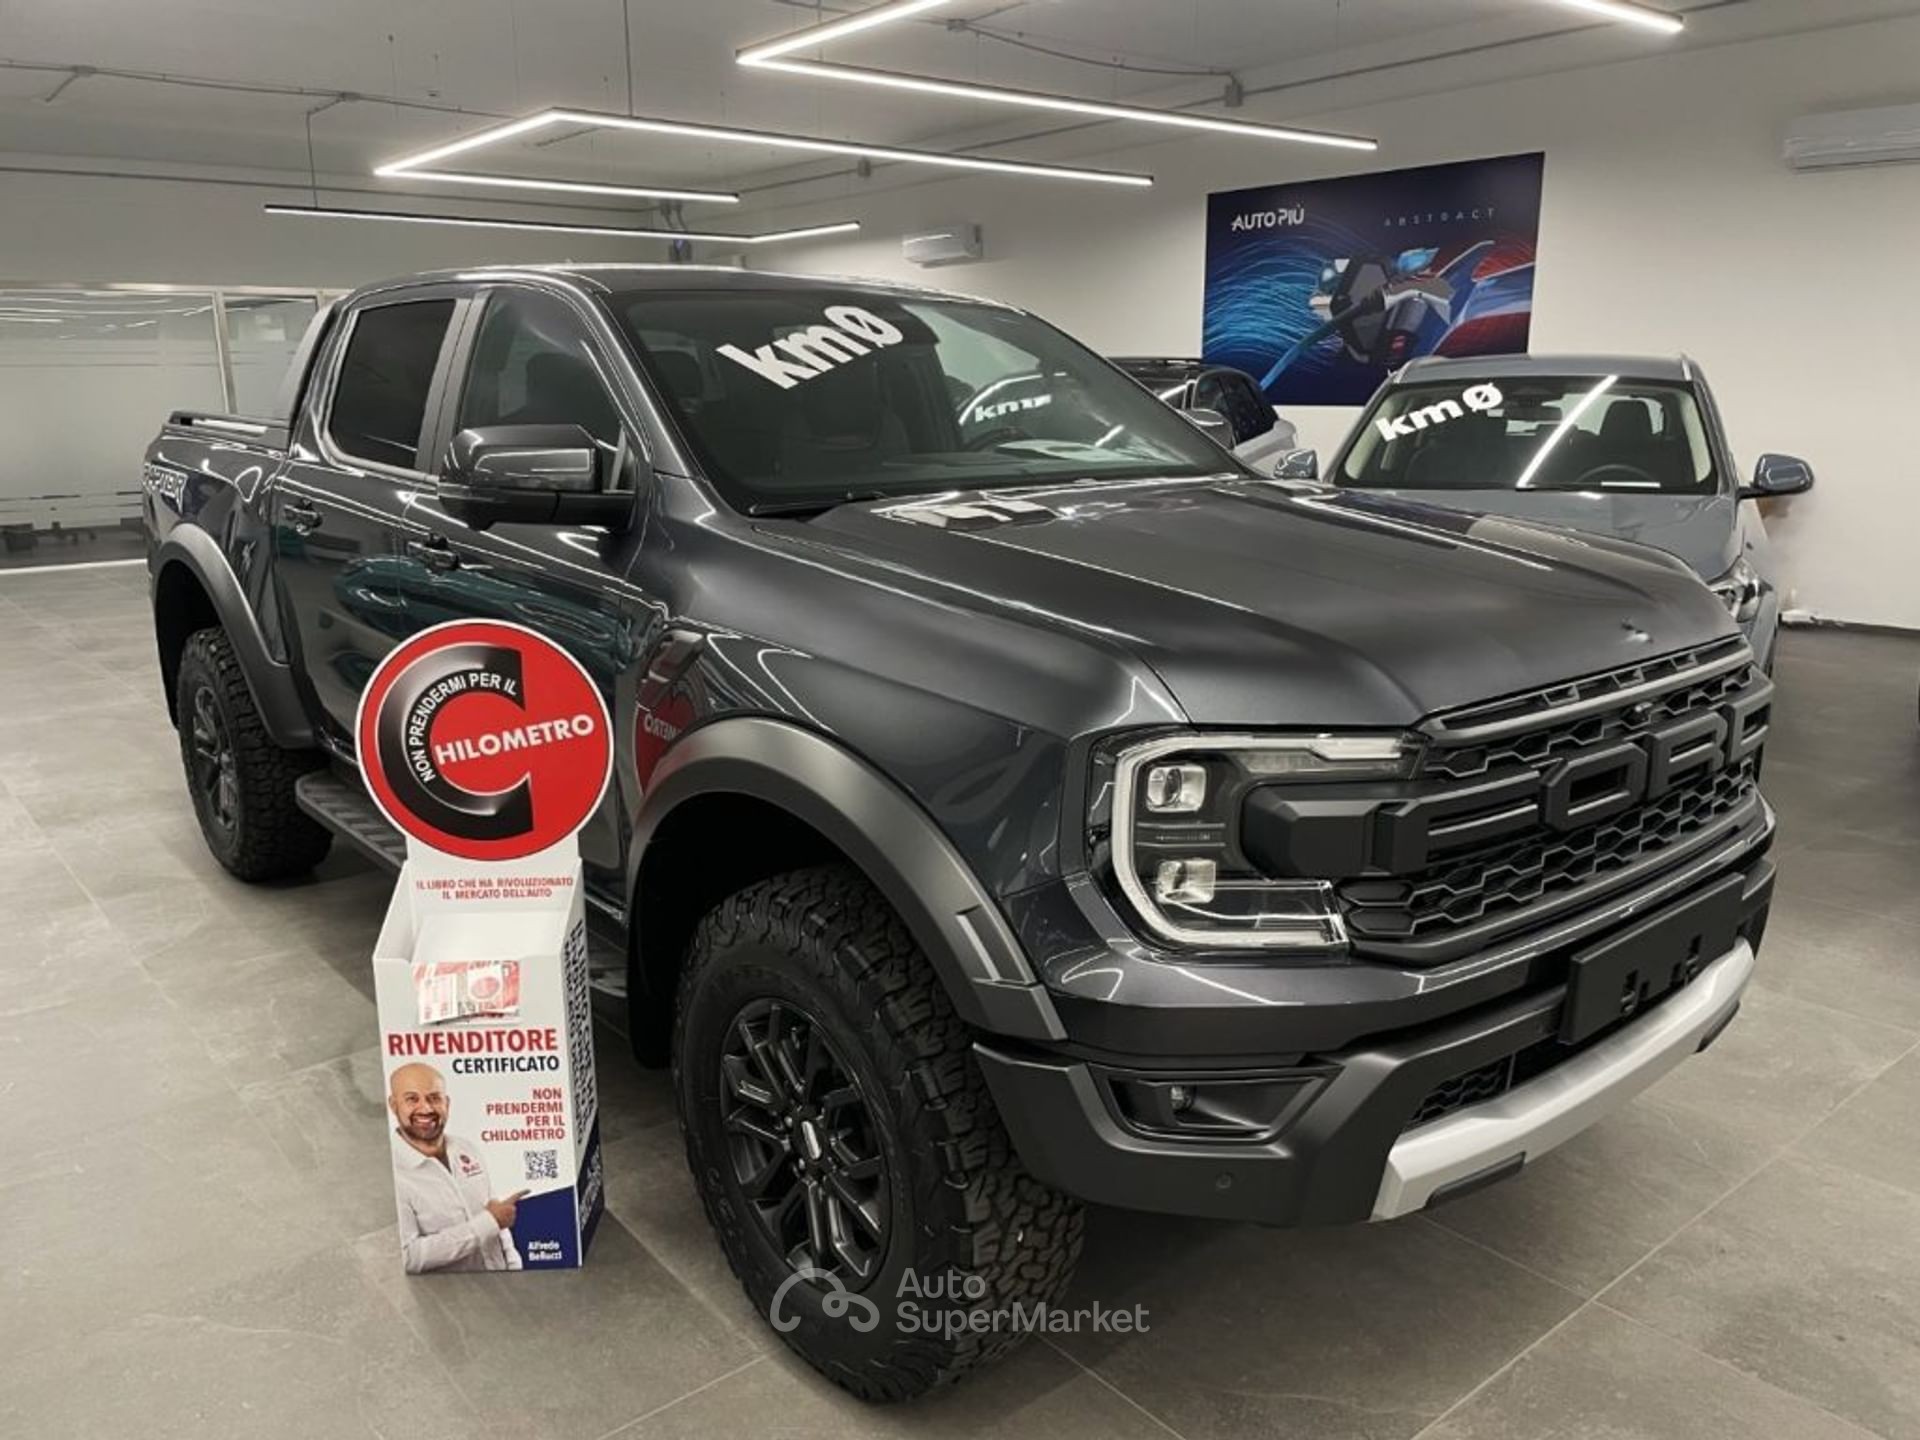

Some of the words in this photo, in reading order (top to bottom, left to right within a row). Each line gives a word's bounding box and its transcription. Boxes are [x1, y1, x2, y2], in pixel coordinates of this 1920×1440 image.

[469, 672, 502, 689] PER
[504, 678, 517, 696] IL
[408, 675, 467, 746] PRENDERMI
[411, 750, 436, 782] NON
[427, 879, 456, 889] LIBRO
[457, 879, 476, 888] CHE
[479, 879, 494, 888] HA
[497, 877, 573, 887] RIVOLUZIONATO
[442, 891, 451, 899] IL
[455, 889, 501, 899] MERCATO
[388, 1029, 558, 1056] RIVENDITORE
[452, 1056, 560, 1074] CERTIFICATO
[532, 1087, 562, 1100] NON
[486, 1102, 563, 1116] PRENDERMI
[525, 1115, 550, 1127] PER
[553, 1115, 565, 1126] IL
[481, 1128, 565, 1142] CHILOMETRO
